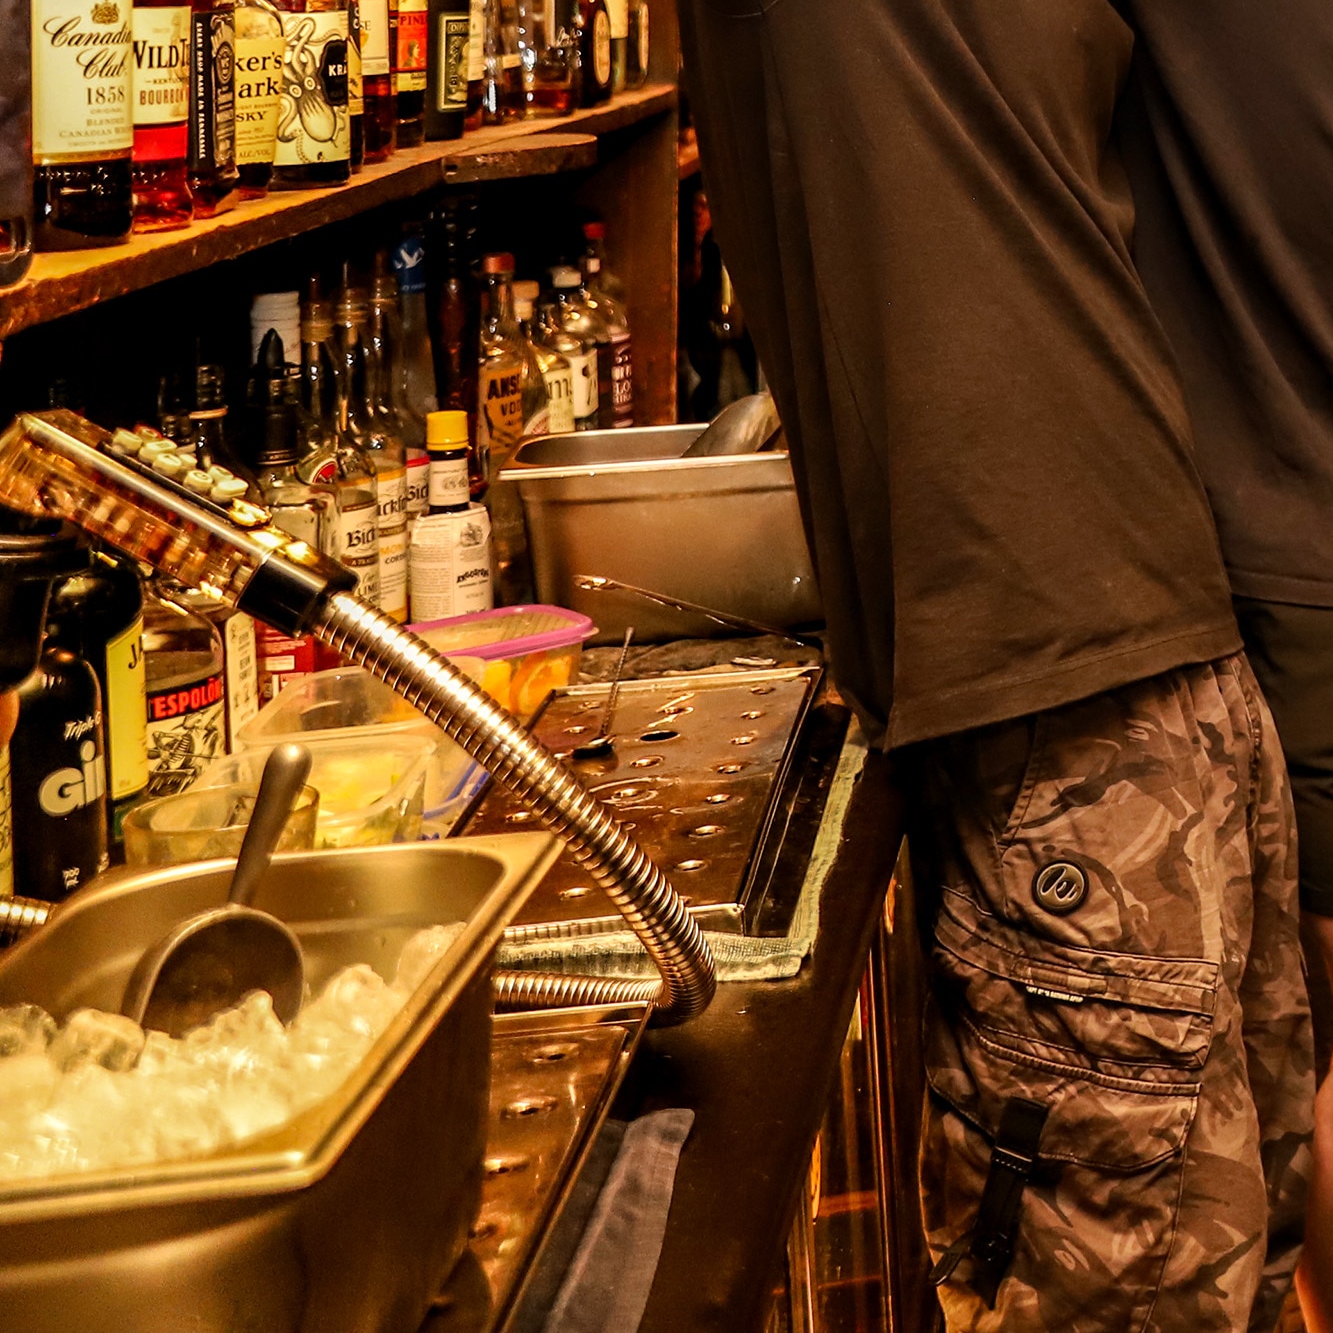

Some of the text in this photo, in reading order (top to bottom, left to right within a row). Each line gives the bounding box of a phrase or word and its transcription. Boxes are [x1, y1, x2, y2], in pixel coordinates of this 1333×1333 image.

[75, 46, 127, 80] Club
[86, 86, 125, 106] 1858
[238, 77, 280, 99] ark
